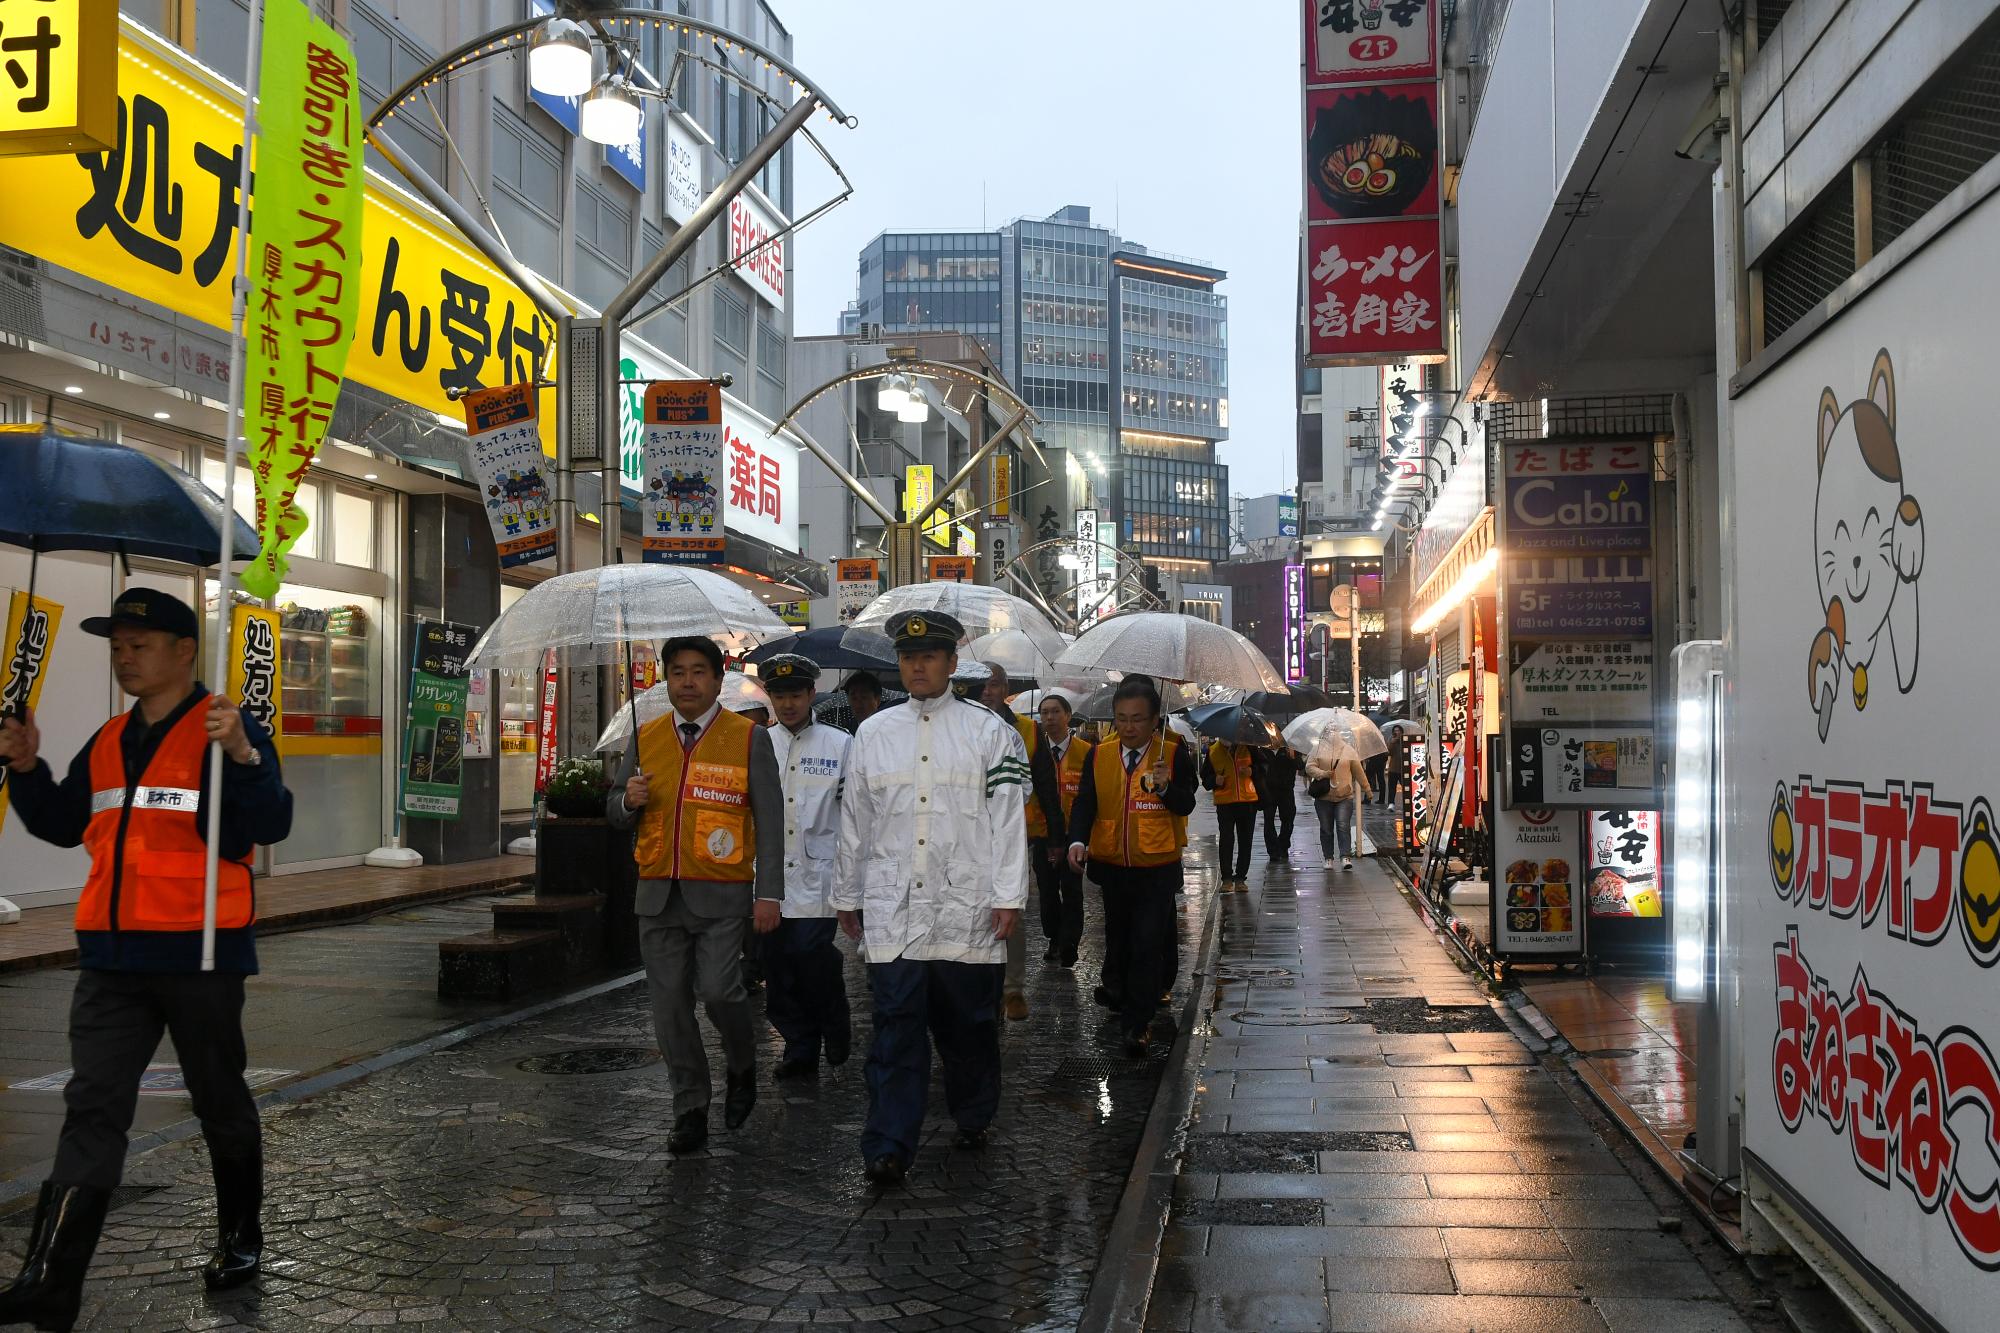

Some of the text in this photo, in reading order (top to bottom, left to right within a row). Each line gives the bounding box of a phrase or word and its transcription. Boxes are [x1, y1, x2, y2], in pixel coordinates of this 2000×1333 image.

[1358, 39, 1390, 59] 2F
[1312, 244, 1435, 286] ラーメン
[1312, 291, 1437, 339] 壱角家
[1514, 445, 1640, 473] たばこ
[729, 434, 781, 525] 薬局
[1176, 481, 1208, 495] DAYS
[1513, 479, 1642, 526] Cabin
[1517, 533, 1642, 549] Jazz and Live place
[1289, 571, 1299, 619] SLOT
[1519, 589, 1551, 612] 5F
[1559, 616, 1646, 627] 046-221-0785
[1290, 627, 1299, 668] PIA
[1521, 666, 1647, 683] 厚木ダンススクール
[1541, 707, 1559, 716] TEL
[693, 772, 733, 788] Safety
[803, 766, 834, 777] POLICE
[693, 786, 743, 805] Network
[1515, 833, 1562, 844] Akatsuki
[1791, 780, 1960, 940] カラオケ
